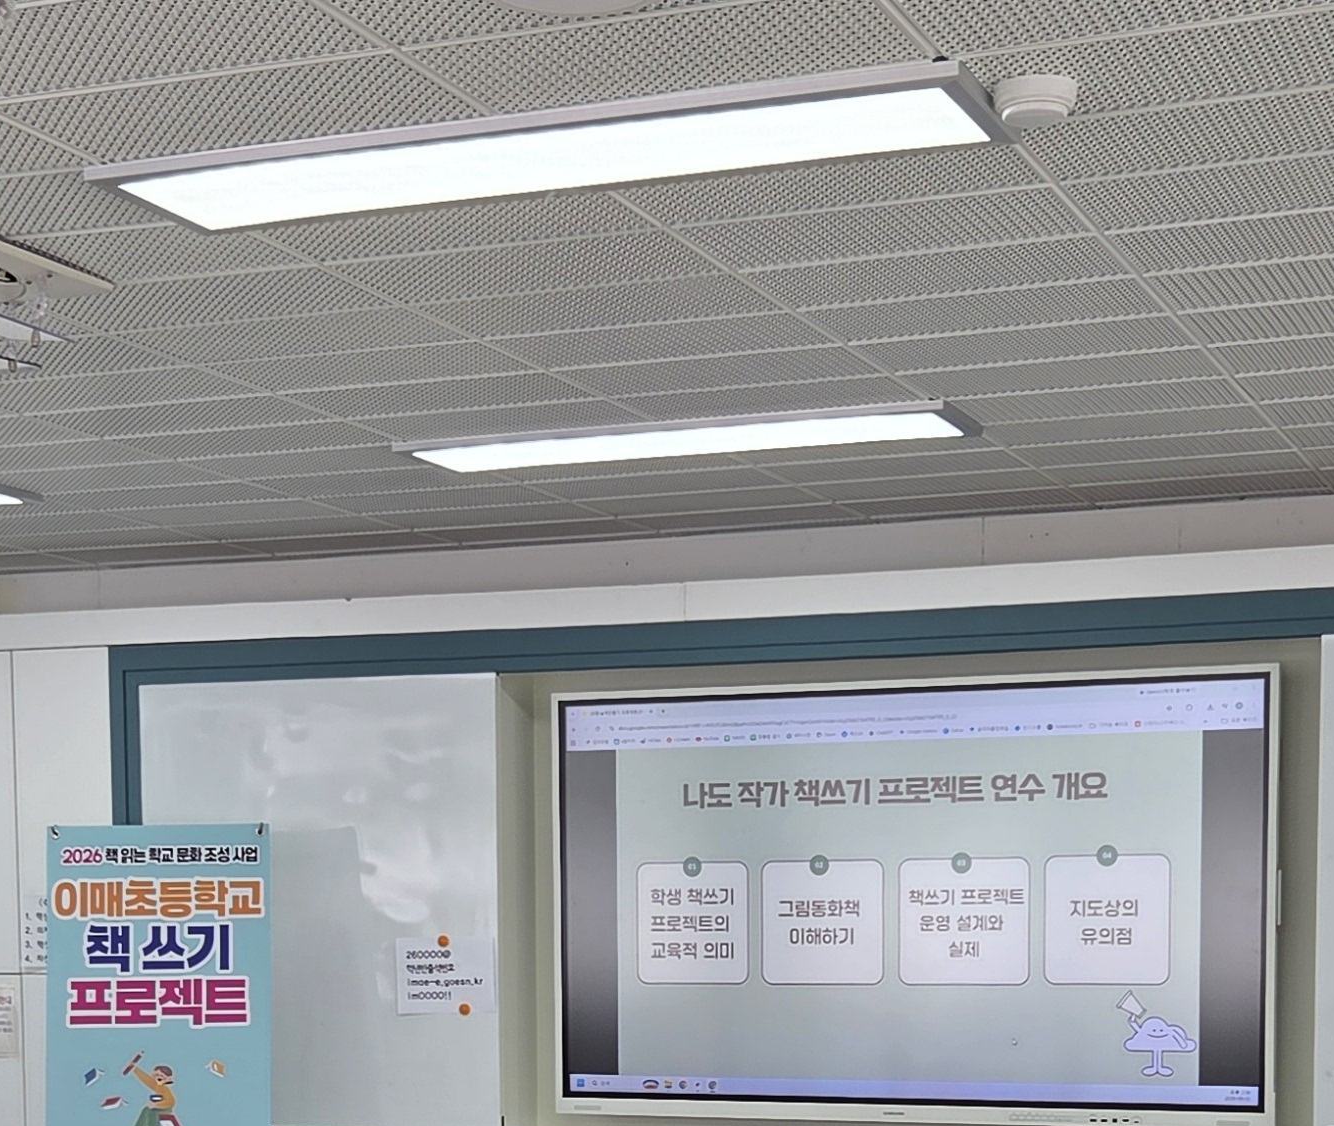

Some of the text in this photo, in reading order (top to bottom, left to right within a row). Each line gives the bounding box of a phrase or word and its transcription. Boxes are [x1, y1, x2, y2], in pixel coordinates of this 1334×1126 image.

[683, 771, 1108, 809] 나도 작가 책쓰기 프로젝트 연수 개요
[62, 846, 258, 864] 2026 책 읽는 학교 문화 조성 사업
[53, 878, 263, 918] 이매초등학교
[650, 887, 735, 906] 학생 책쓰기
[908, 888, 1025, 906] 책쓰기 프로젝트
[778, 899, 860, 918] 그림동화책
[1069, 899, 1139, 918] 지도상의
[650, 915, 730, 932] 프로젝트의
[919, 914, 1004, 932] 운영 설계와
[789, 927, 855, 946] 이해하기
[1080, 927, 1133, 946] 유의점
[86, 924, 231, 973] 책 쓰기
[650, 941, 735, 960] 교육적 의미
[948, 941, 980, 958] 실제
[69, 978, 247, 1026] 프로젝트
